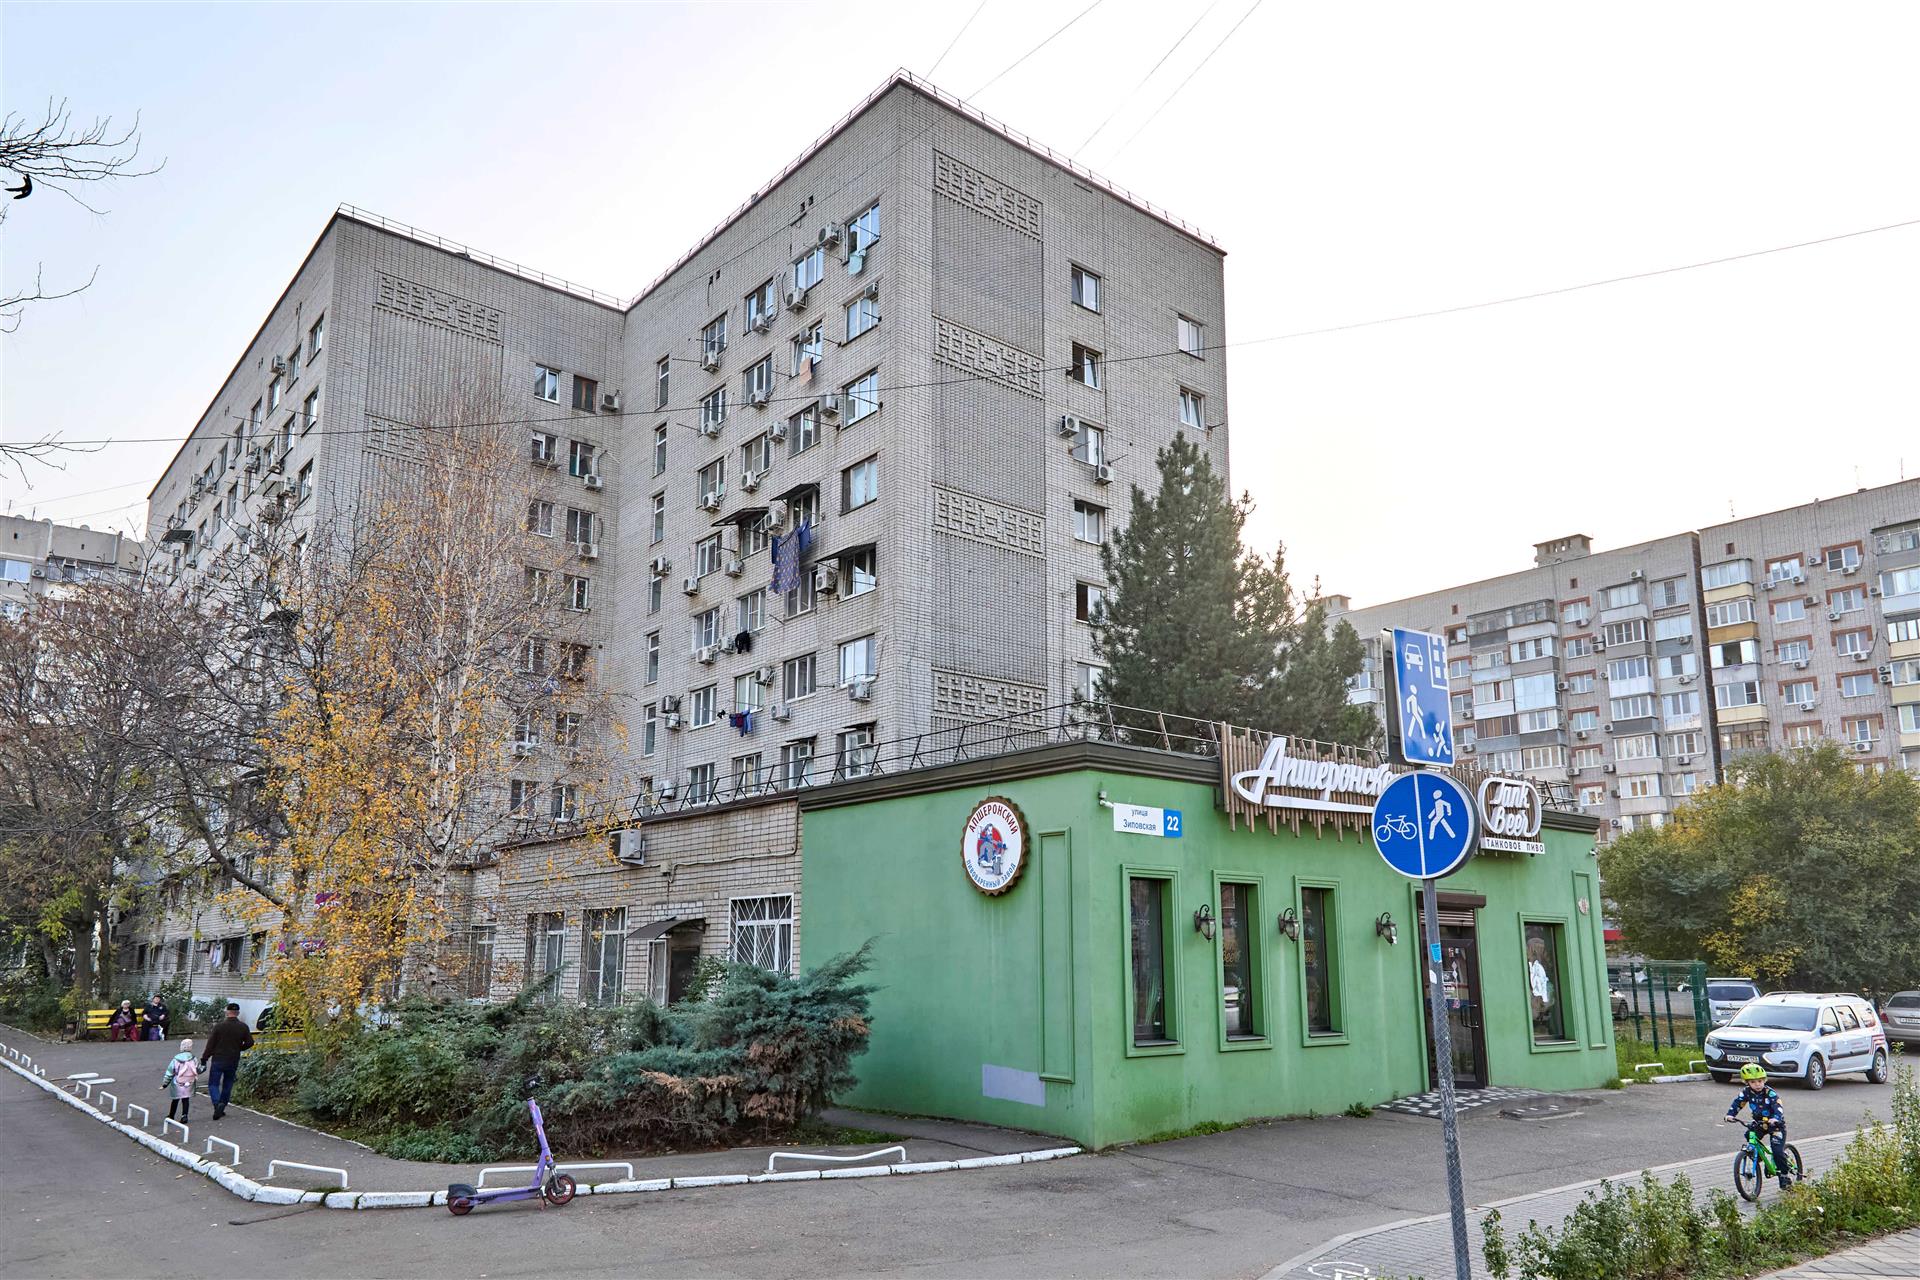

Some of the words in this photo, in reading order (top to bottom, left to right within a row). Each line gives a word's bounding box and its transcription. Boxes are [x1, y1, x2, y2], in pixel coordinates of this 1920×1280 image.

[1123, 818, 1157, 831] Зиповская
[1166, 815, 1179, 831] 22
[1490, 806, 1529, 836] Beer
[1486, 838, 1522, 851] ТАНКОВОЕ
[1526, 842, 1544, 853] ПИВО
